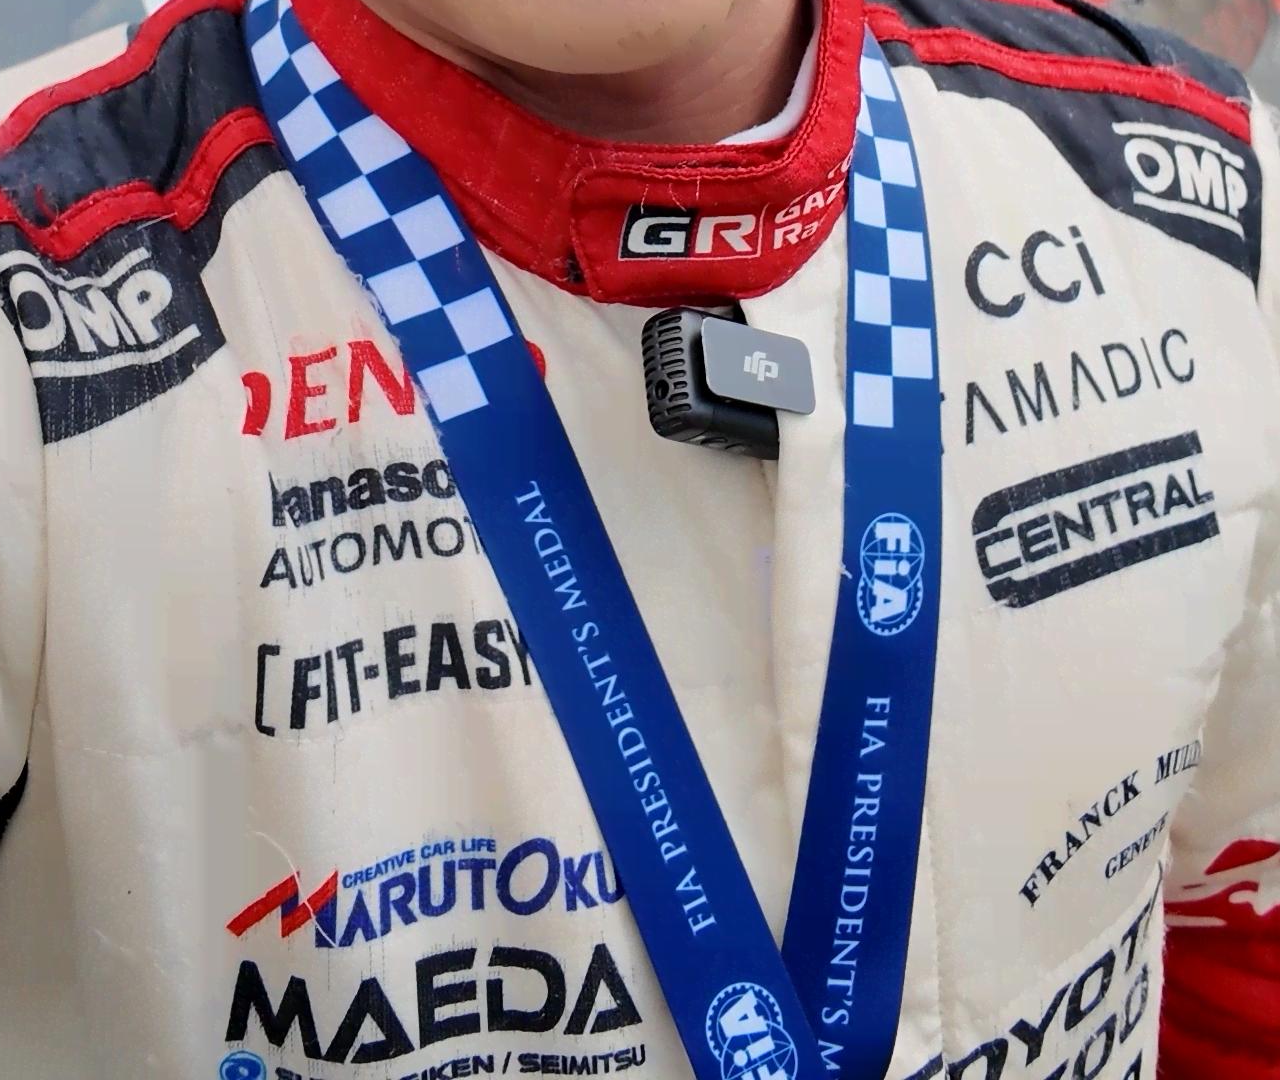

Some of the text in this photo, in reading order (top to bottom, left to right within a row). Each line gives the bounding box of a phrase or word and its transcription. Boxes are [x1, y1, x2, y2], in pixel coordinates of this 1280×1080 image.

[1123, 137, 1249, 220] OMP
[626, 215, 756, 255] GR
[6, 265, 176, 356] OMP
[942, 328, 1196, 447] AMADIC
[974, 468, 1215, 580] CENTRAL
[514, 480, 718, 938] FIA PRESIDENT'S MEDAL
[854, 696, 892, 758] FIA
[341, 838, 497, 890] CREATIVE CAR LIFE
[1018, 769, 1142, 910] FRANCK
[821, 772, 882, 1027] PRESIDENT'S
[223, 942, 644, 1066] MAEDA
[518, 1043, 647, 1078] SEIMITSU
